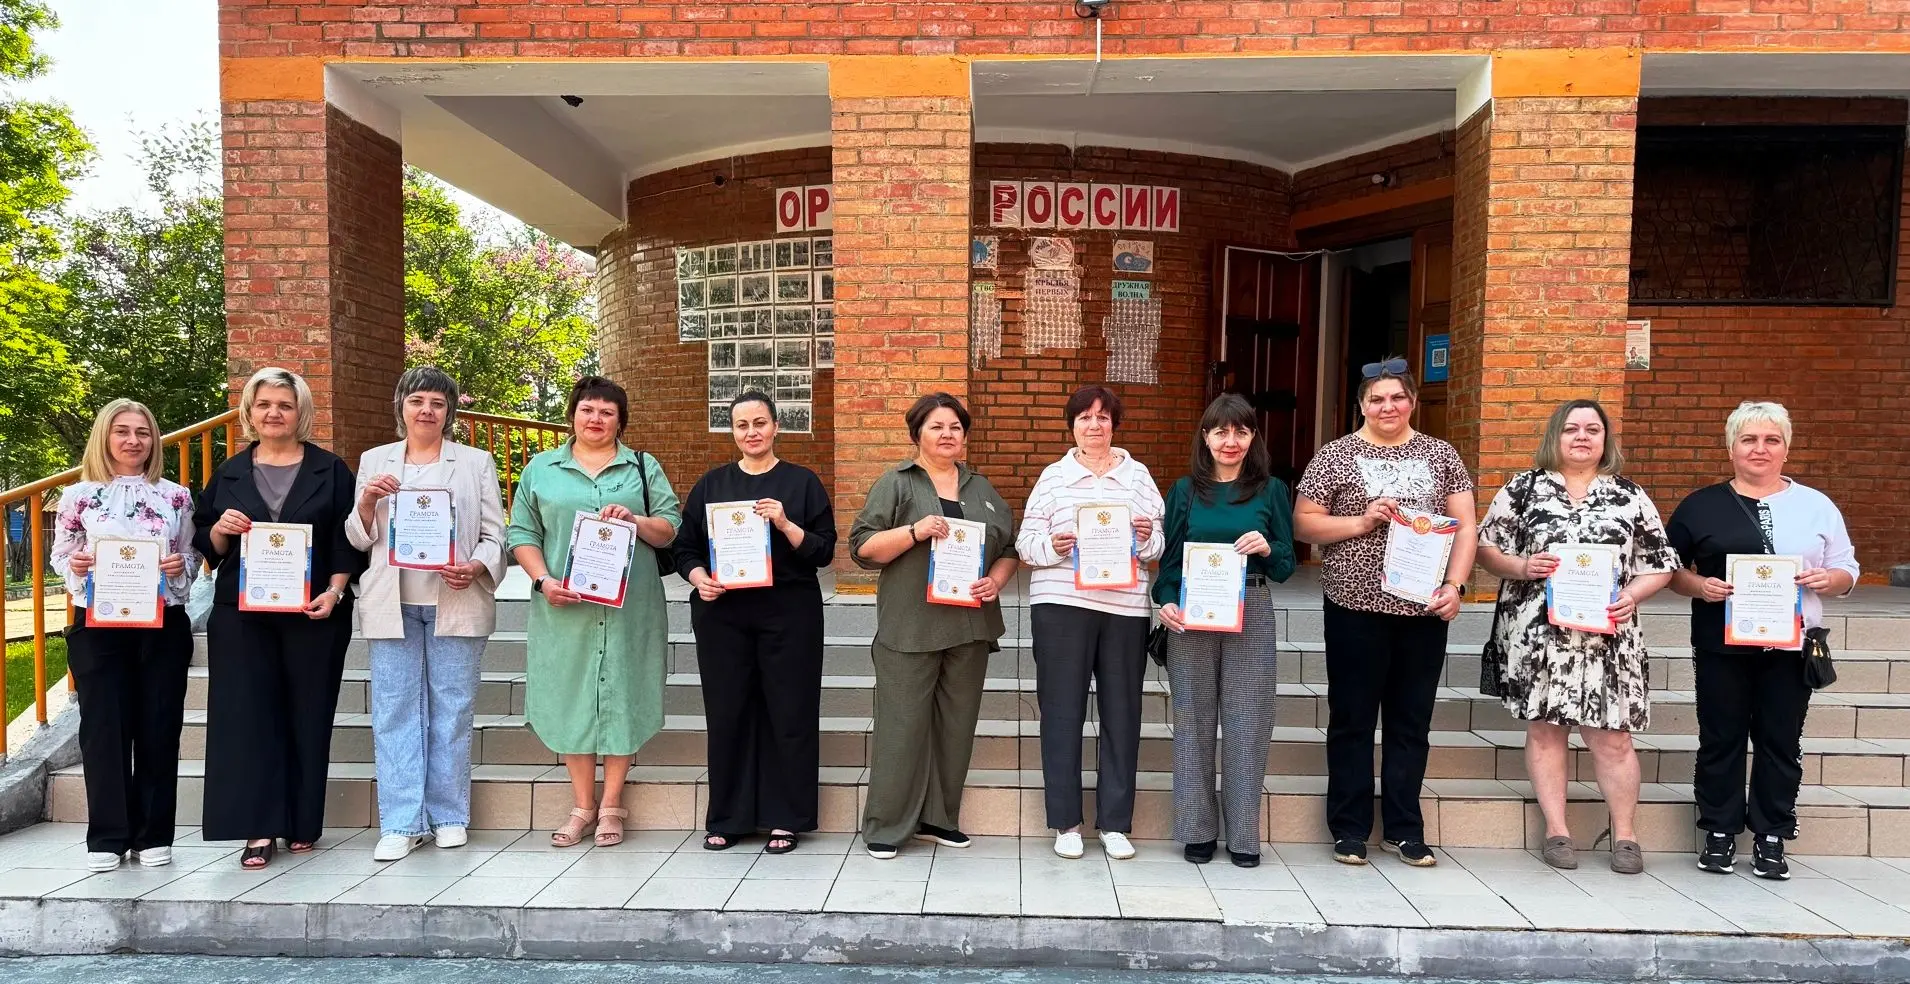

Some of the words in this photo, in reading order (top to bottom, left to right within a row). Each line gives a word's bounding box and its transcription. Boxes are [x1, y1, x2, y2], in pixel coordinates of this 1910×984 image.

[993, 185, 1178, 229] РОССИИ
[1035, 279, 1069, 287] КРЫЛЬЯ
[1112, 281, 1150, 290] ДРУЖНАЯ
[1035, 288, 1069, 296] ПЕРВЫХ
[1117, 291, 1144, 299] ВОЛНА
[111, 562, 145, 570] ГРАМОТА
[1567, 569, 1599, 577] ГРАМОТА
